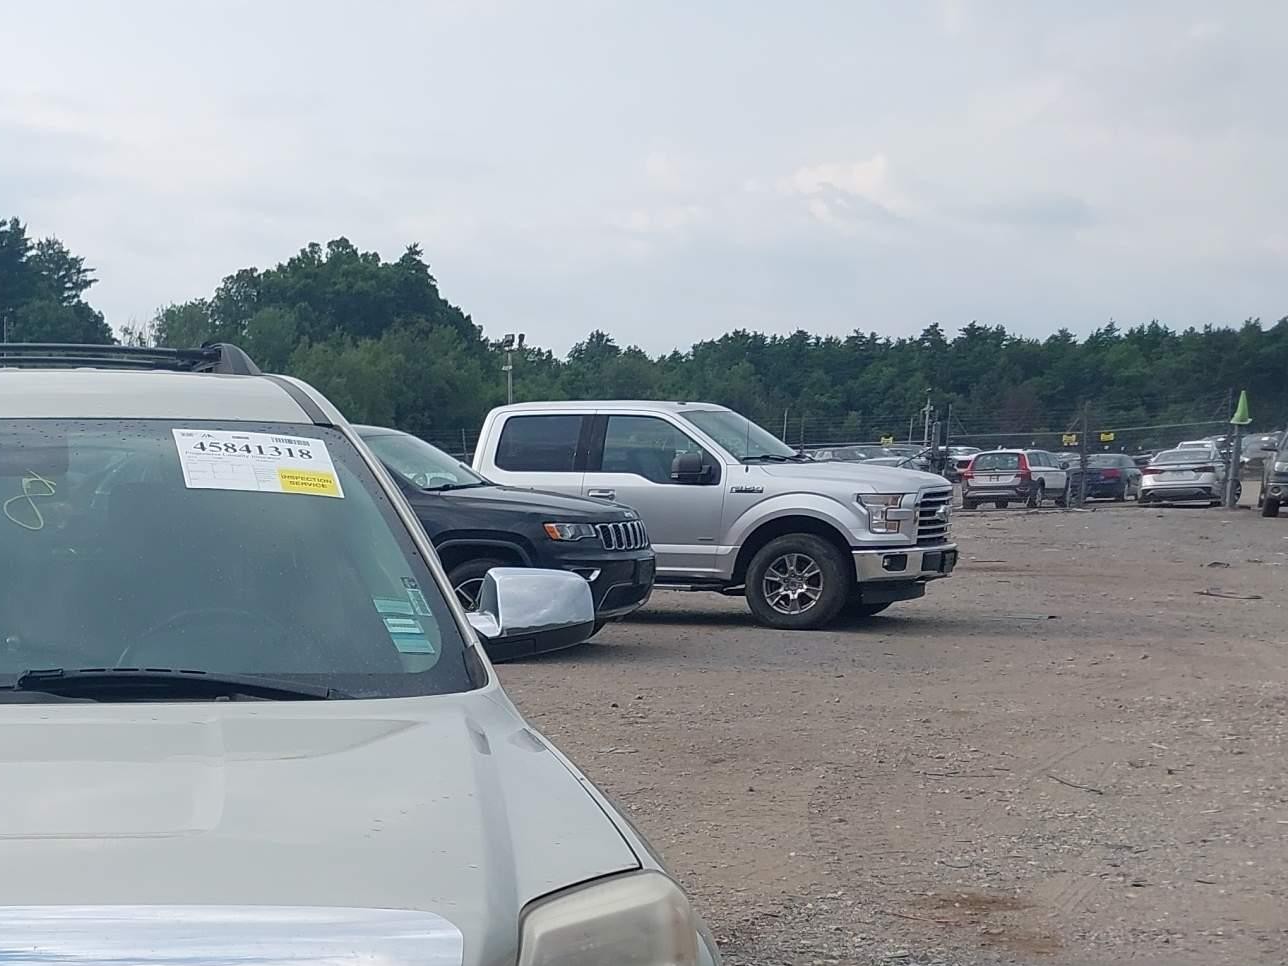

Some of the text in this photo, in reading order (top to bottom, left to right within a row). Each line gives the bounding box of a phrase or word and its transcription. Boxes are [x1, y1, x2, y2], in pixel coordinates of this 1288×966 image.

[193, 441, 313, 460] 45841318
[280, 472, 333, 485] INSPECTION
[289, 480, 328, 489] SERVICE
